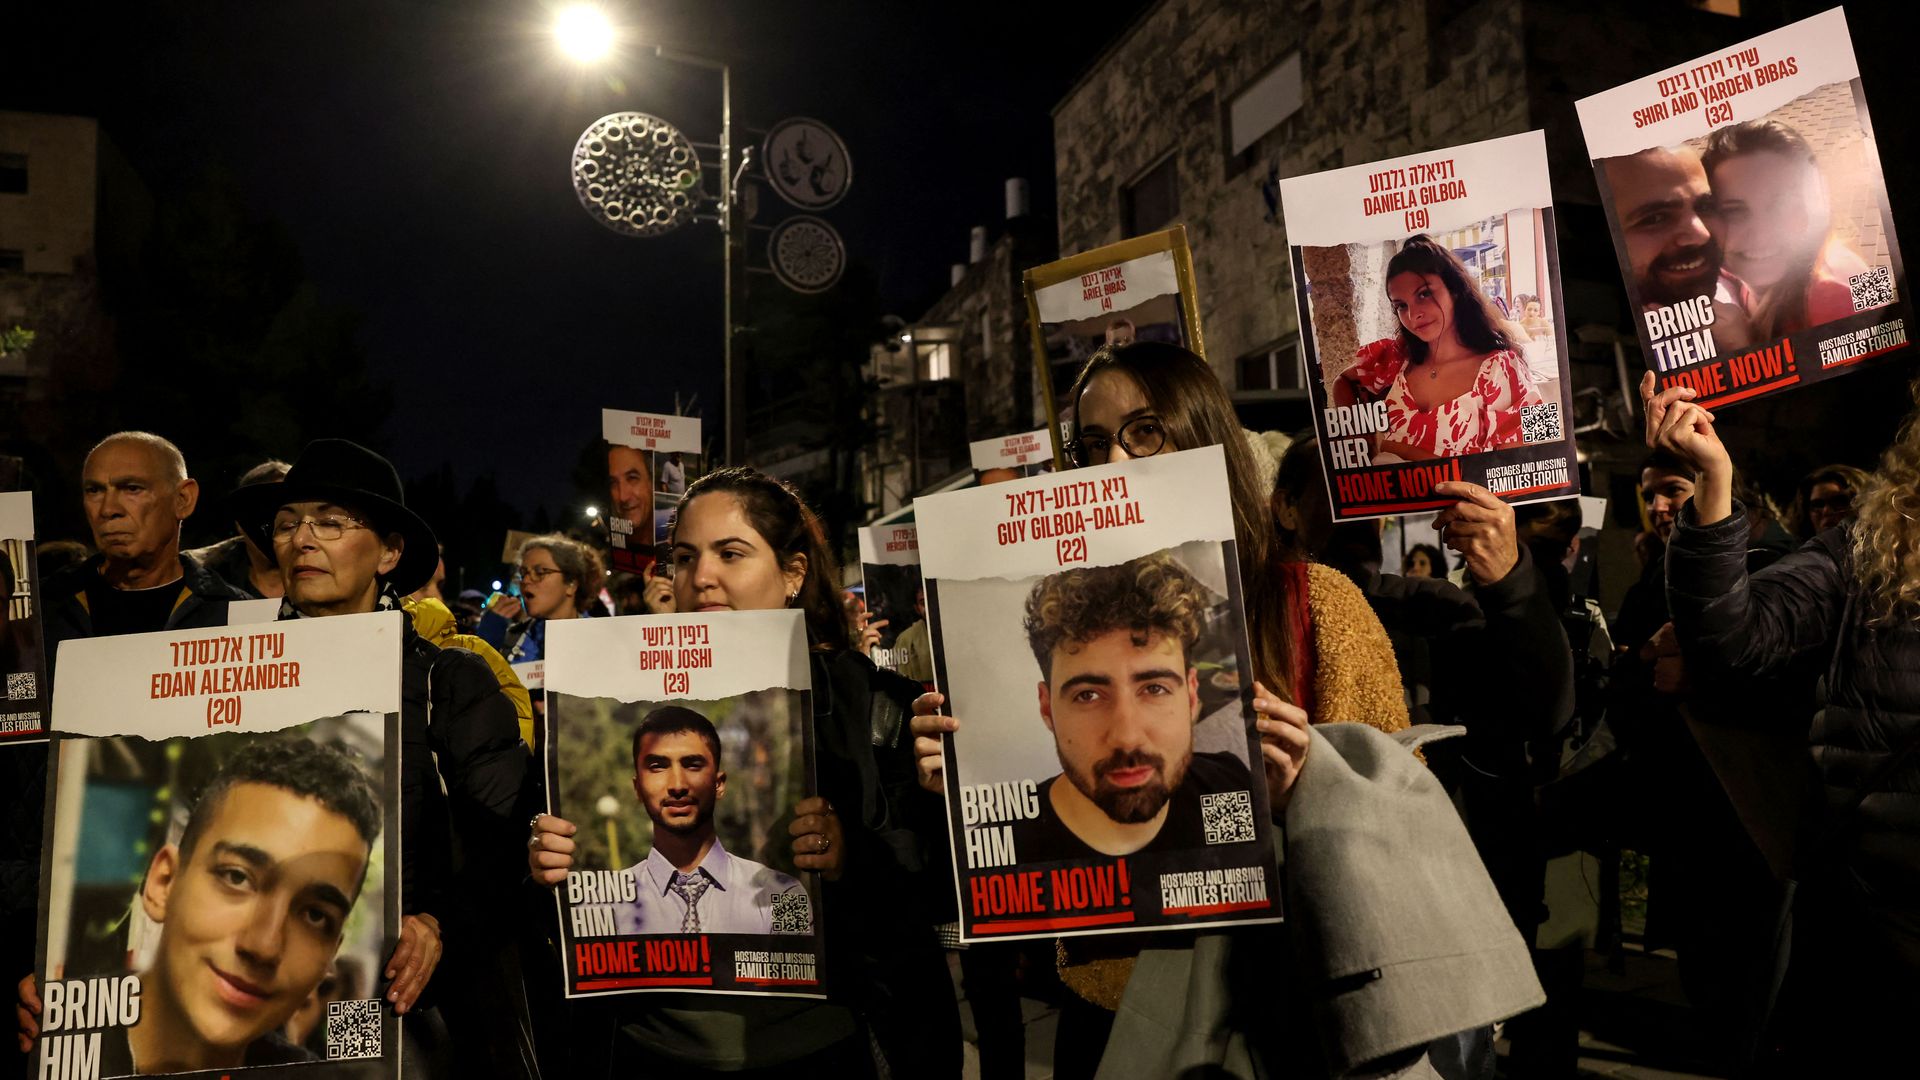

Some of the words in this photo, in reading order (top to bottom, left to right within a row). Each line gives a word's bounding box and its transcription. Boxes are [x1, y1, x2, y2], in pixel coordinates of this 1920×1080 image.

[1691, 59, 1725, 89] וירדן
[1726, 47, 1760, 72] שירי
[1632, 101, 1670, 129] SHIRI
[1671, 91, 1699, 116] AND
[1699, 72, 1754, 105] YARDEN
[1754, 56, 1798, 87] BIBAS
[1657, 72, 1691, 98] ביבס
[1704, 100, 1734, 128] (32)
[1368, 168, 1407, 193] גלבוע
[1408, 159, 1455, 186] דניאלה
[1363, 189, 1418, 216] DANIELA
[1420, 179, 1468, 206] GILBOA
[1404, 207, 1430, 233] (19)
[1083, 286, 1103, 301] ARIEL
[1104, 279, 1126, 296] BIBAS
[1101, 296, 1113, 311] (4)
[1644, 294, 1715, 341] BRING
[1651, 328, 1717, 372] THEM
[1818, 332, 1855, 352] HOSTAGES
[1855, 328, 1871, 341] AND
[1871, 318, 1904, 337] MISSING
[1820, 343, 1868, 366] FAMILIES
[1868, 329, 1907, 353] FORUM
[1729, 338, 1796, 388] NOW!
[1324, 399, 1389, 438] BRING
[1330, 437, 1372, 470] HER
[1486, 464, 1521, 479] HOSTAGES
[1521, 462, 1536, 474] AND
[1536, 457, 1567, 472] MISSING
[1101, 476, 1129, 502] גיא
[1336, 469, 1396, 504] HOME
[1487, 474, 1531, 493] FAMILIES
[1533, 468, 1569, 488] FORUM
[1006, 481, 1098, 517] גלבוע-דלאל
[610, 516, 633, 536] BRING
[997, 519, 1026, 546] GUY
[1031, 501, 1145, 540] GILBOA-DALAL
[611, 532, 627, 549] HIM
[1056, 535, 1088, 566] (22)
[248, 633, 285, 663] עידן
[677, 624, 710, 647] ביפין
[170, 636, 243, 667] אלכסנדר
[640, 649, 673, 671] BIPIN
[677, 648, 712, 669] JOSHI
[874, 648, 909, 666] BRING
[151, 670, 196, 699] EDAN
[200, 662, 300, 695] ALEXANDER
[663, 671, 690, 695] (23)
[7, 713, 17, 721] AND
[18, 711, 40, 720] MISSING
[15, 719, 41, 732] FORUM
[206, 695, 242, 728] (20)
[960, 778, 1040, 825] BRING
[965, 825, 1017, 869] HIM
[567, 870, 637, 904] BRING
[970, 871, 1046, 917] HOME
[1049, 858, 1132, 912] NOW!
[1160, 871, 1205, 889] HOSTAGES
[1206, 868, 1224, 885] AND
[1225, 866, 1265, 884] MISSING
[1162, 885, 1219, 909] FAMILIES
[1221, 880, 1268, 905] FORUM
[571, 906, 618, 937] HIM
[576, 940, 641, 976] HOME
[646, 935, 712, 973] NOW!
[735, 950, 769, 964] HOSTAGES
[770, 952, 784, 964] AND
[785, 952, 816, 965] MISSING
[735, 962, 780, 980] FAMILIES
[781, 963, 816, 981] FORUM
[42, 975, 140, 1032] BRING
[38, 1032, 102, 1080] HIM
